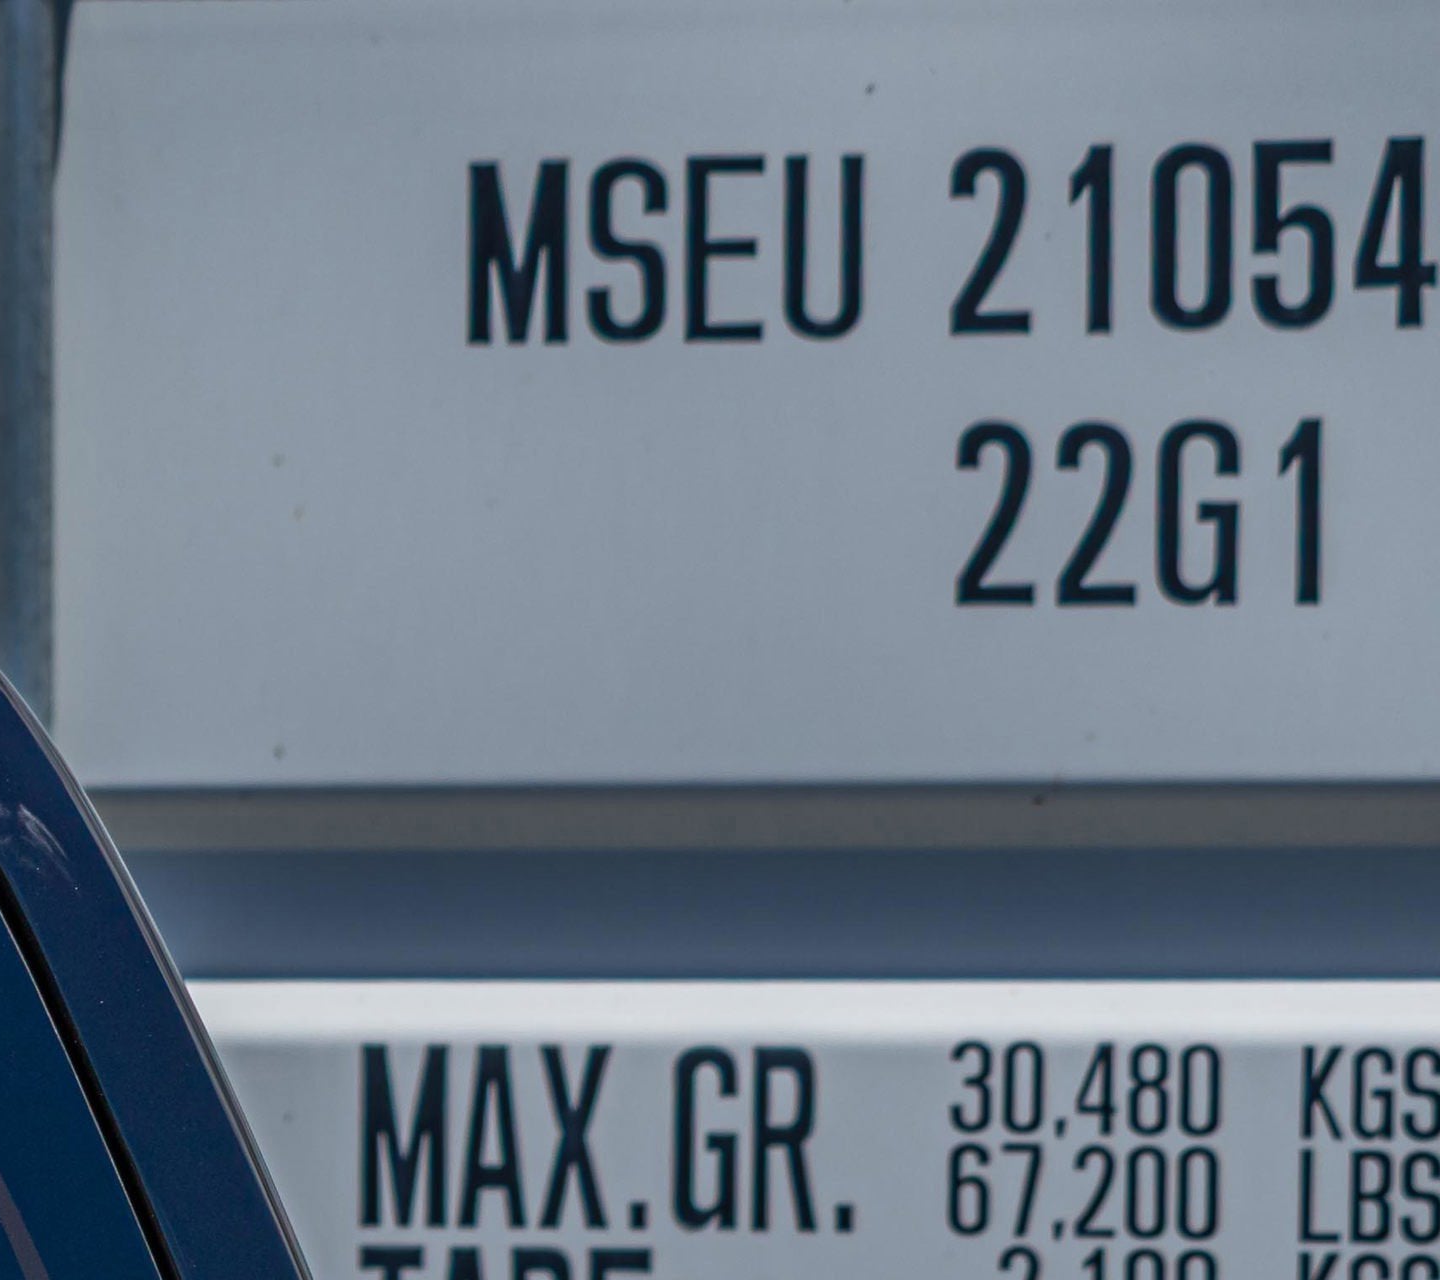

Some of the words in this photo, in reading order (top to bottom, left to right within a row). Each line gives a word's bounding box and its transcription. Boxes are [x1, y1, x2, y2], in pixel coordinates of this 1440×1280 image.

[467, 153, 866, 346] MSEU
[948, 135, 1440, 336] 21054
[953, 416, 1323, 607] 22G1
[358, 1042, 857, 1234] MAX.GR.
[948, 1039, 1222, 1139] 30,480
[1298, 1044, 1440, 1142] KGS
[946, 1142, 1221, 1242] 67,200
[1296, 1147, 1440, 1246] LBS
